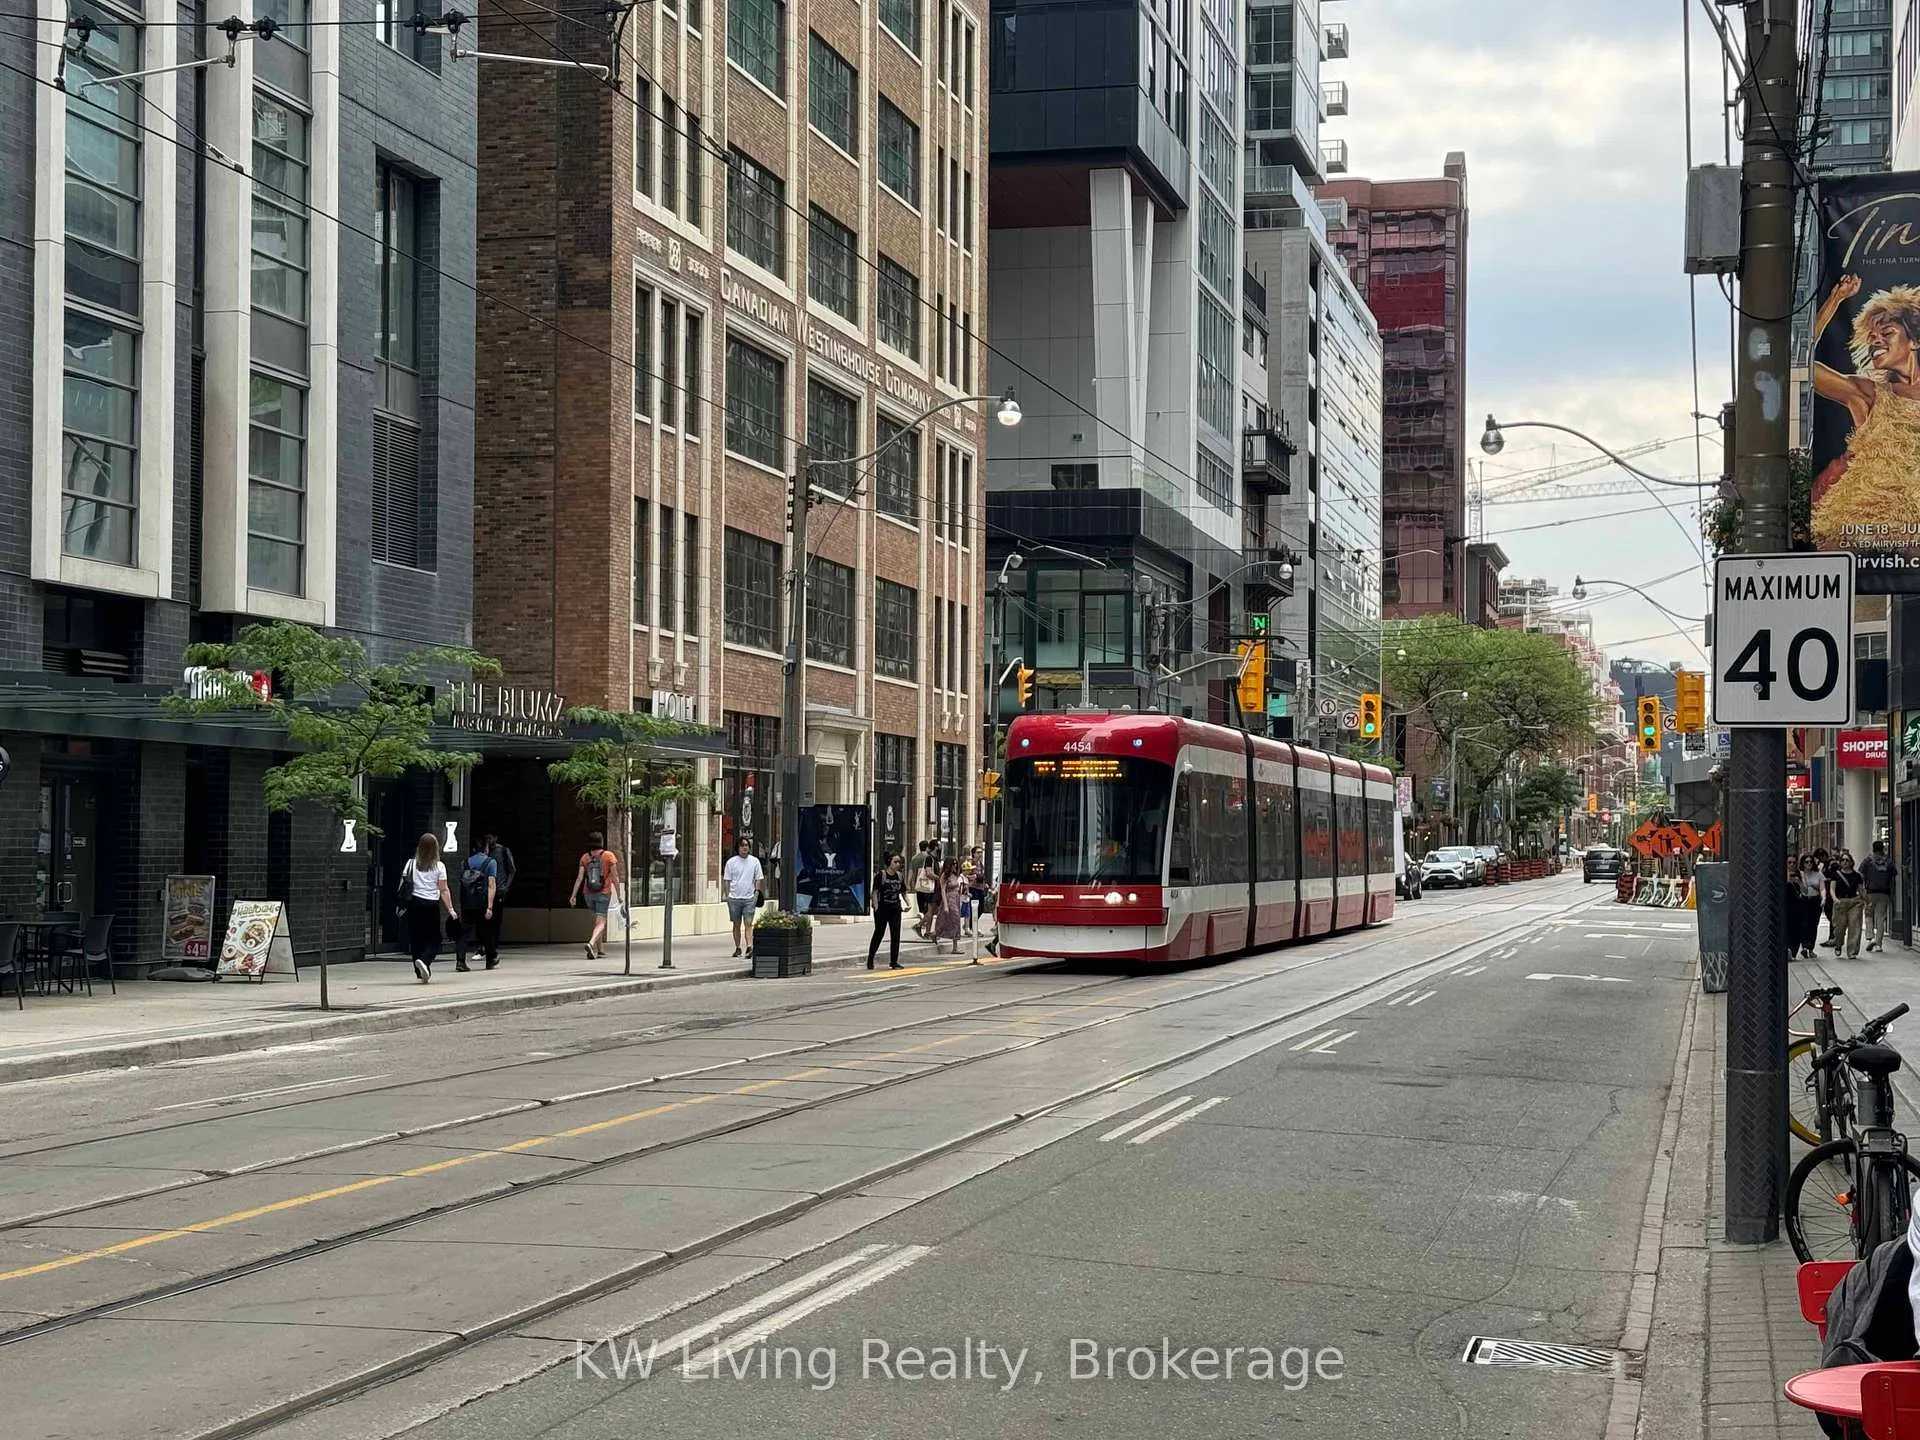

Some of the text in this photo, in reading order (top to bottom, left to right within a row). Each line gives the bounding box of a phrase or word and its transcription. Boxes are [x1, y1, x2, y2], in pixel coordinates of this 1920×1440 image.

[1862, 258, 1876, 266] THE
[1879, 257, 1897, 265] TINA
[720, 267, 932, 411] CANADIAN WESTINGHOUSE COMPANY
[1839, 524, 1873, 535] JUNE
[1876, 523, 1889, 535] 18
[1872, 539, 1909, 548] MIRVISH
[1857, 554, 1920, 569] irvish.c
[1725, 574, 1841, 600] MAXIMUM
[1723, 627, 1840, 702] 40
[652, 690, 698, 721] HOTEL
[1063, 741, 1092, 752] 4454
[1865, 751, 1887, 759] DRUG
